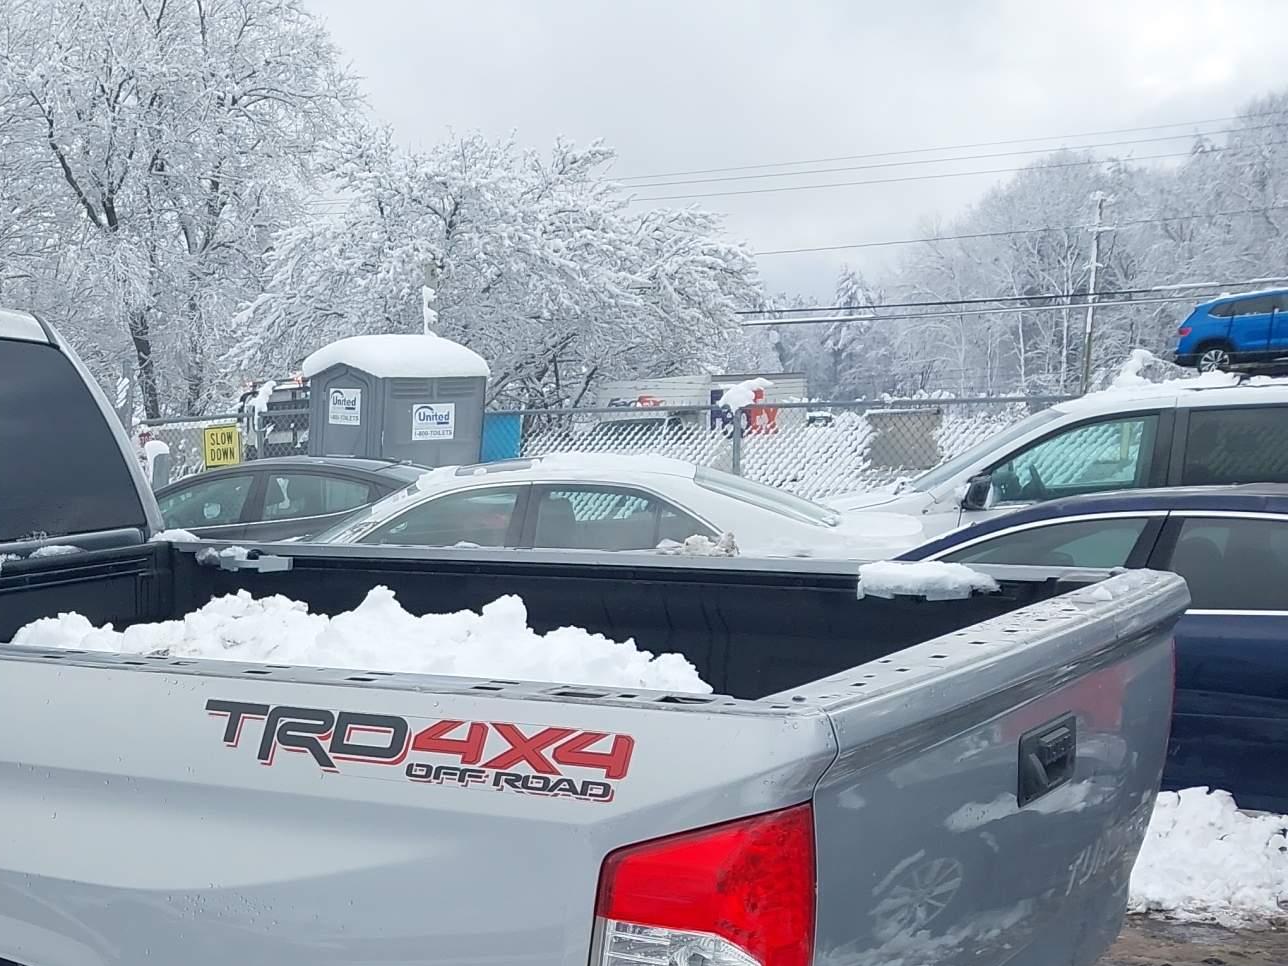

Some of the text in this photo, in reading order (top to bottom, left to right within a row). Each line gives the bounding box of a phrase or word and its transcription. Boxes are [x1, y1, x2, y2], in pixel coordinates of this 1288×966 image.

[332, 396, 357, 407] United
[417, 410, 451, 422] United
[210, 431, 233, 447] SLOW
[210, 446, 235, 462] DOWN
[205, 698, 411, 774] TRD
[405, 762, 615, 803] OFF ROAD
